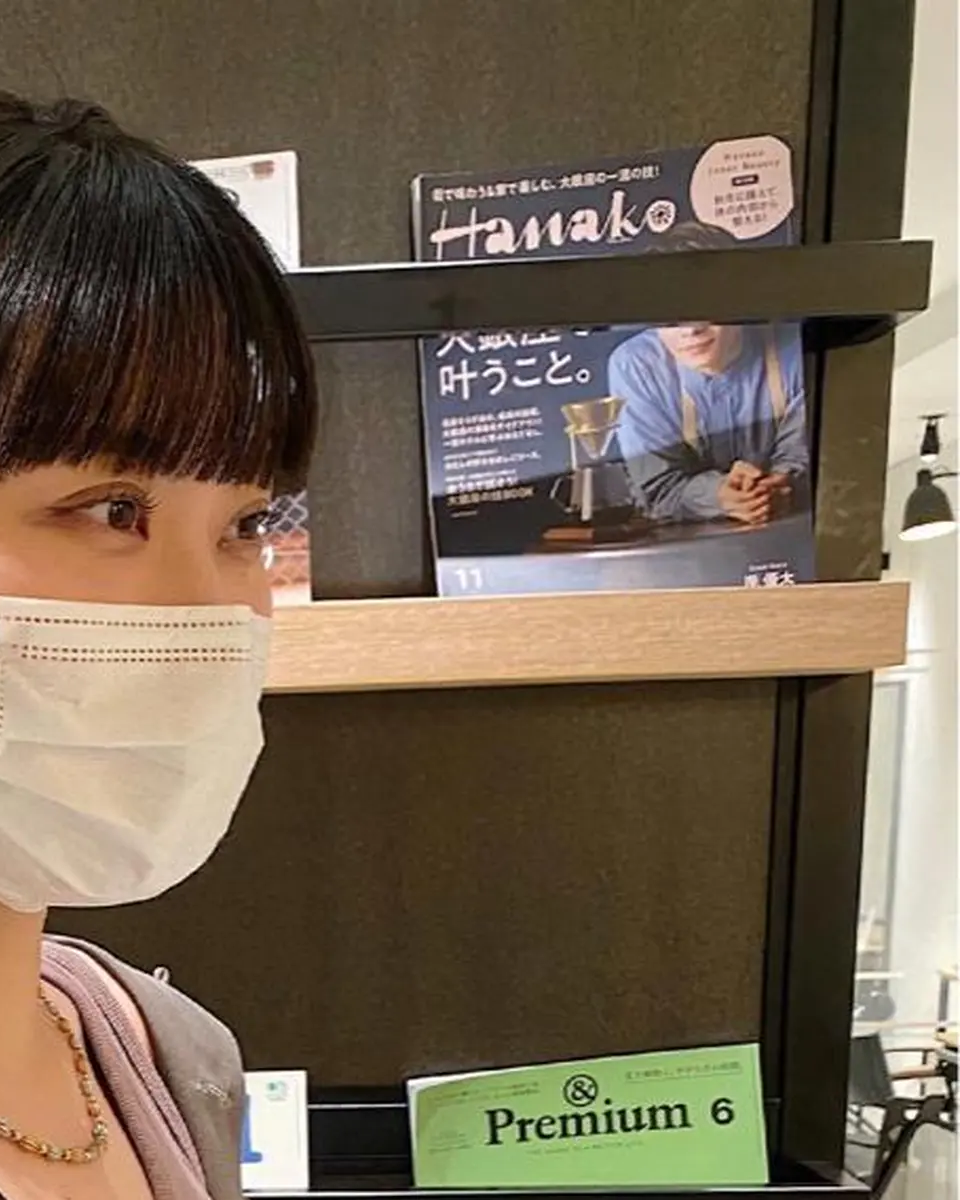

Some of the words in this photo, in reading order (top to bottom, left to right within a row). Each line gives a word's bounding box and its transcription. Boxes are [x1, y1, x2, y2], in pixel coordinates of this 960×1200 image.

[429, 190, 676, 260] Hanako
[439, 350, 592, 401] 叶うこと。
[455, 568, 483, 590] 11
[565, 1077, 596, 1106] &
[484, 1097, 694, 1146] Premium
[711, 1097, 735, 1126] 6
